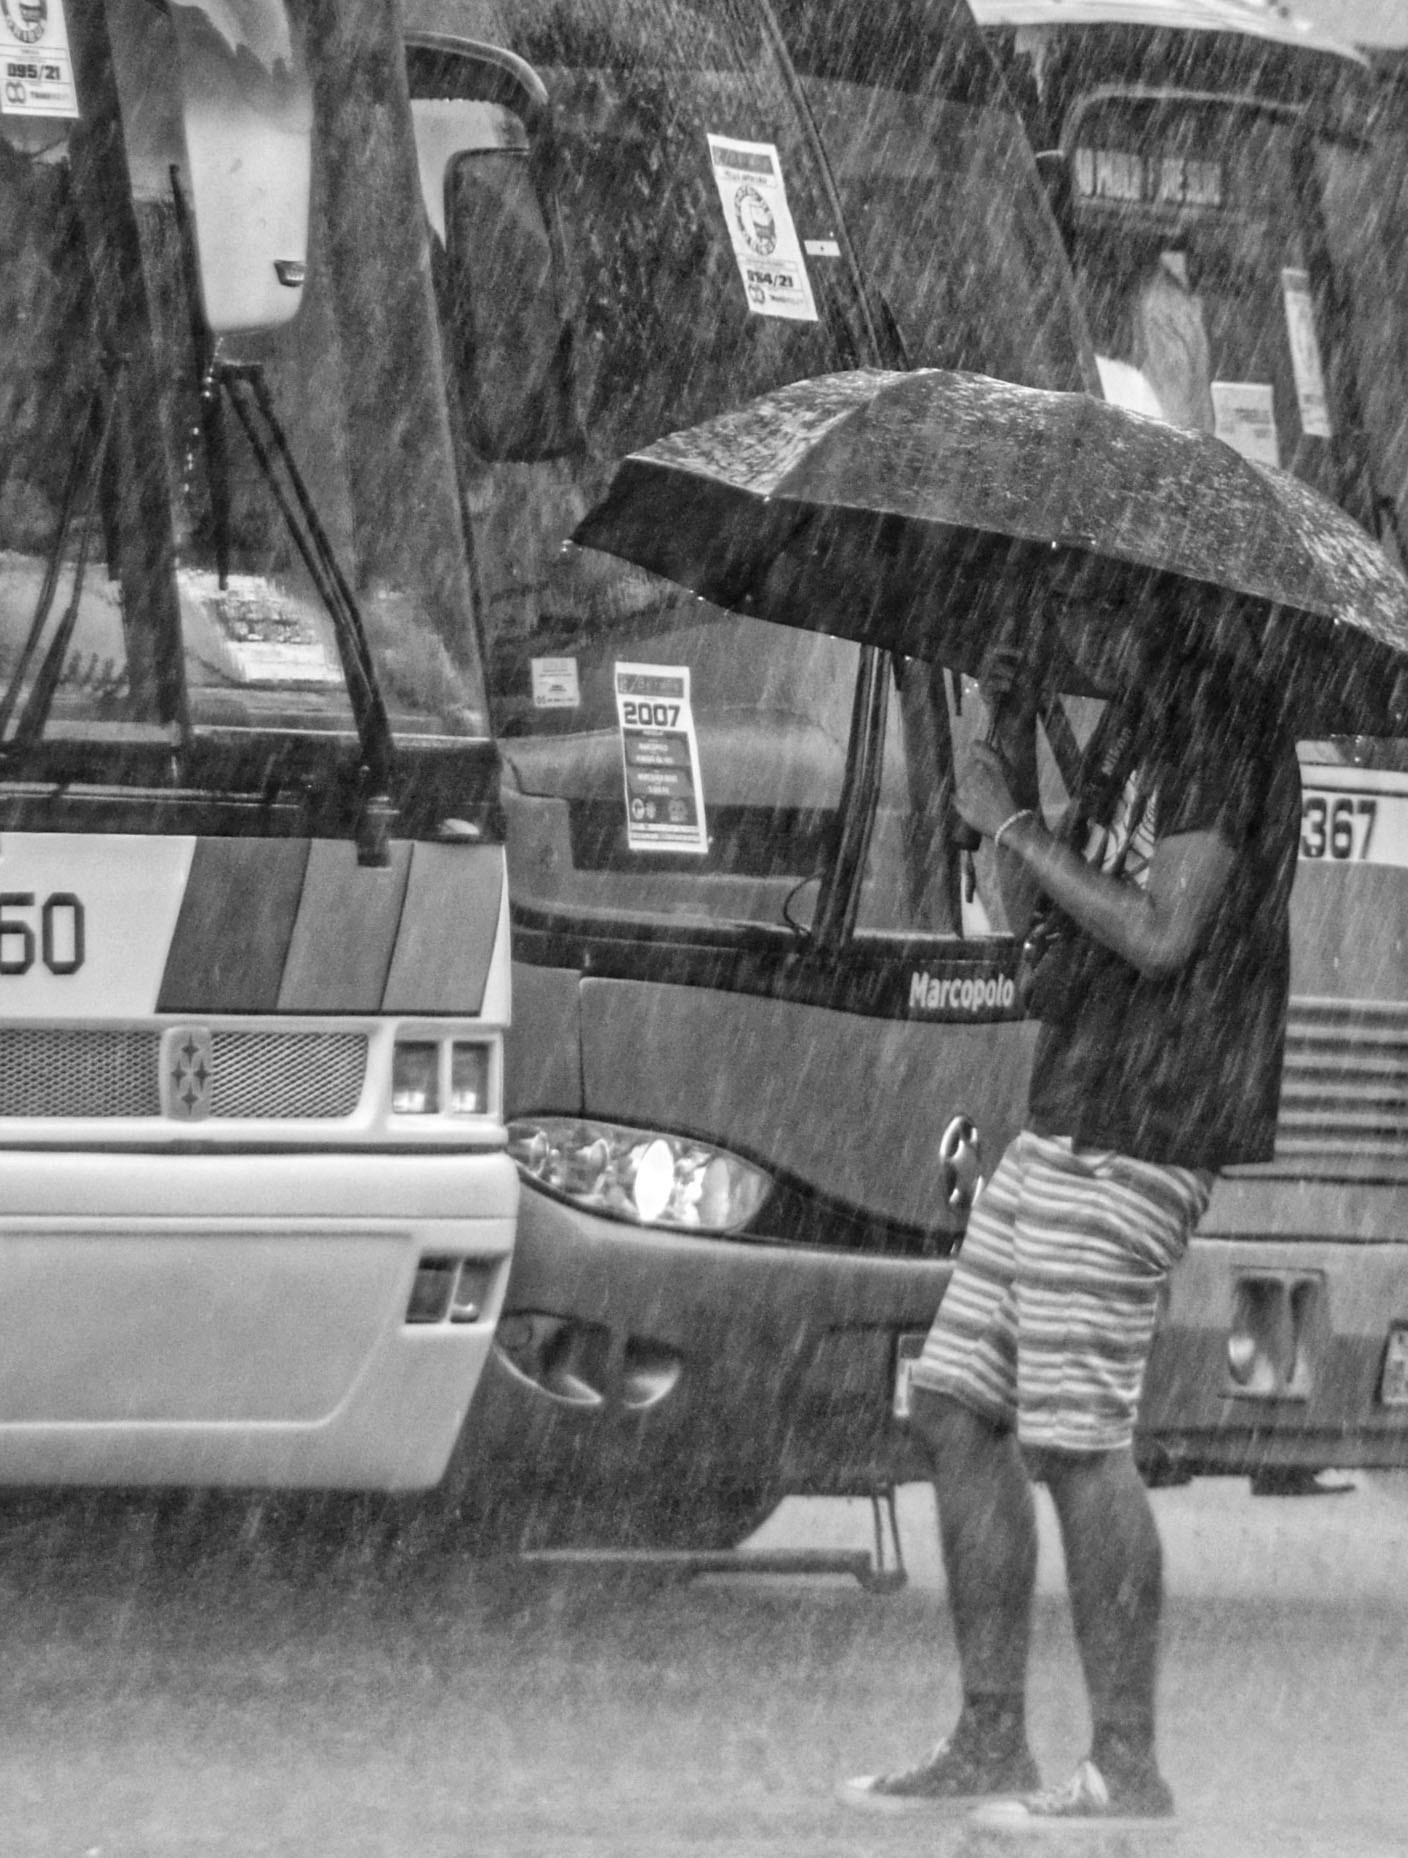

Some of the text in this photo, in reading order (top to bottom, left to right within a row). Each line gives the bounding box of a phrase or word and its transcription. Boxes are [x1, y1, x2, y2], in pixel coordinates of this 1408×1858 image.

[623, 701, 681, 727] 2007
[1301, 797, 1377, 860] 367
[908, 970, 1015, 1012] Marcopolo
